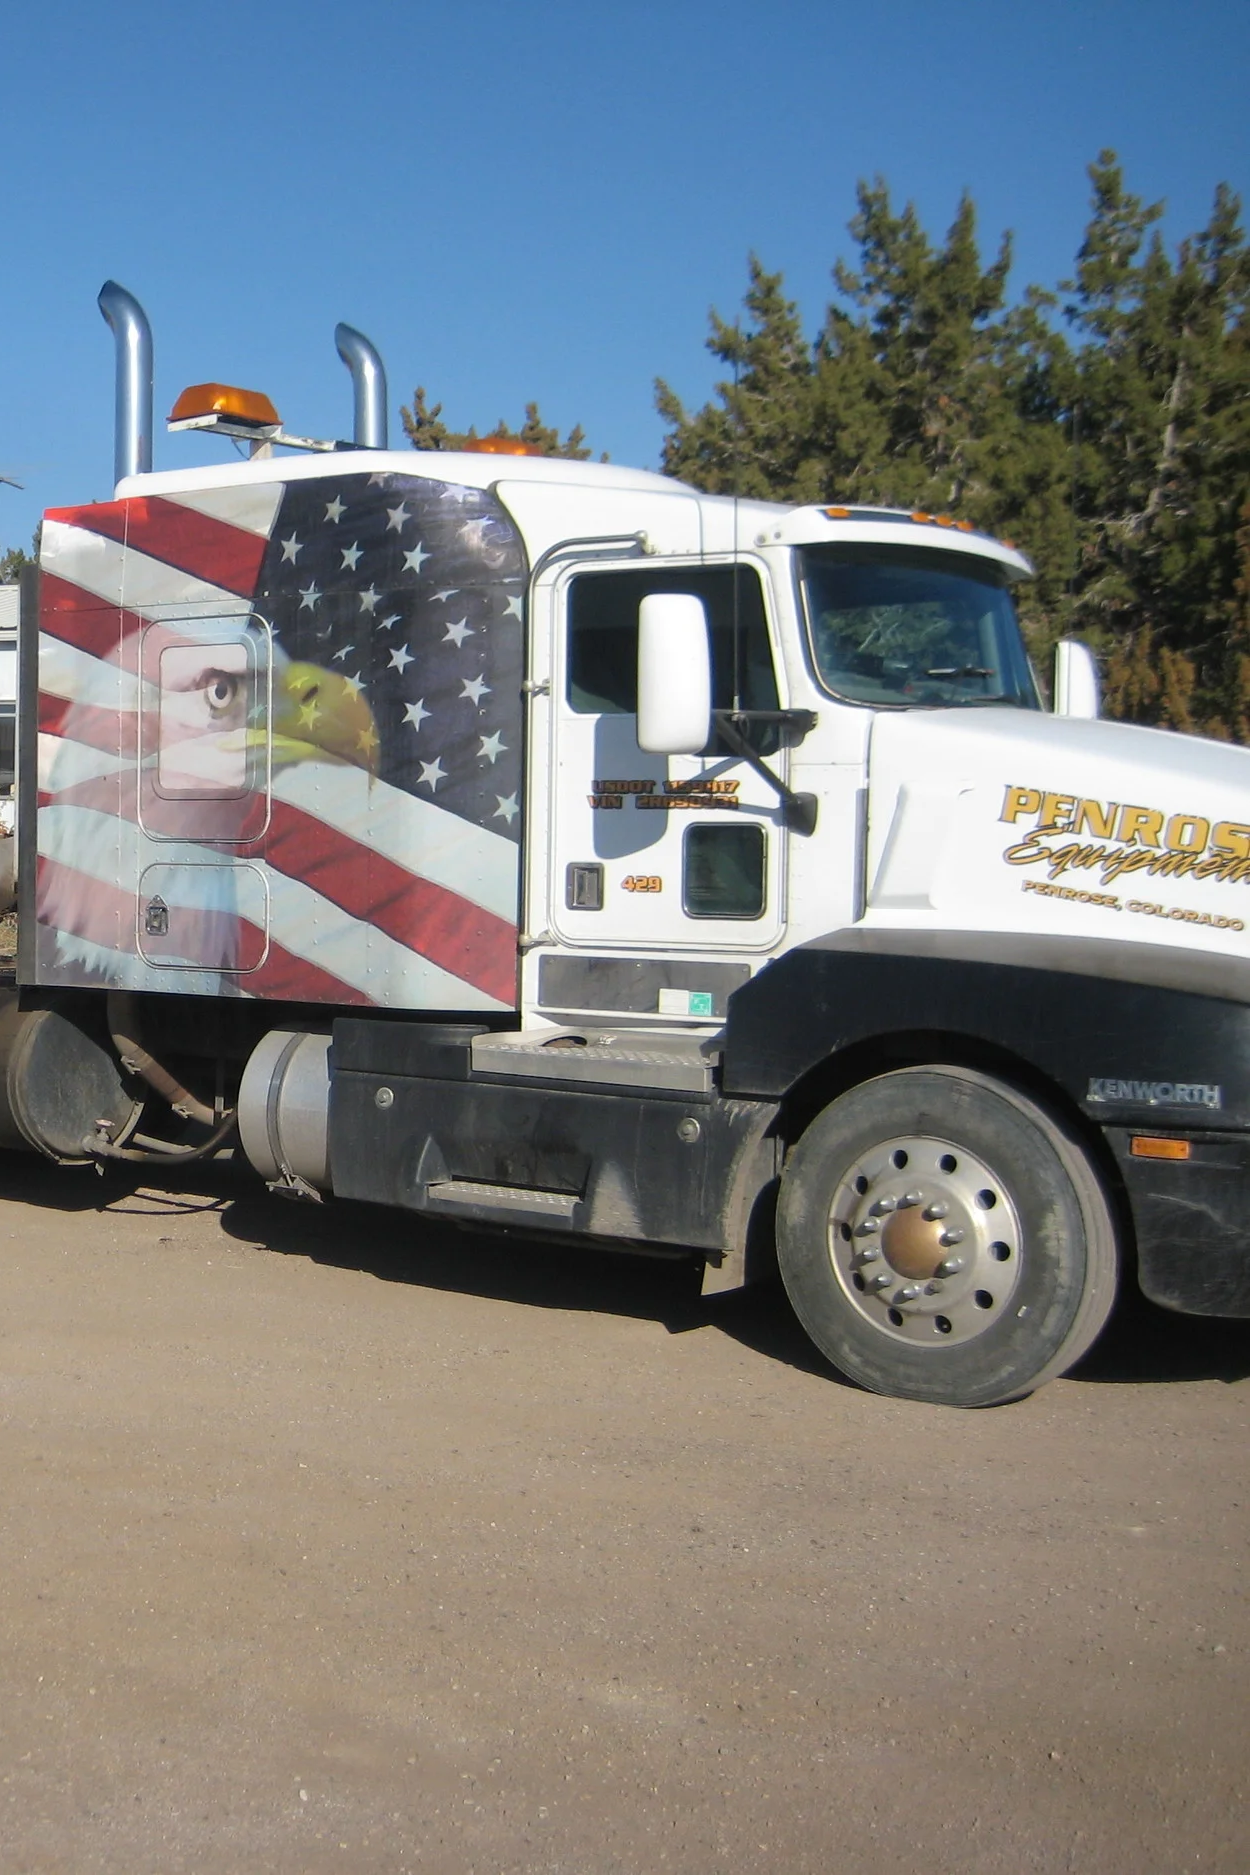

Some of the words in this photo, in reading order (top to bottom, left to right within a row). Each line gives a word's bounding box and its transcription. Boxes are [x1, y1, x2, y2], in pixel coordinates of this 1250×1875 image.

[592, 780, 655, 794] USDOT
[587, 795, 623, 809] VIN
[621, 875, 662, 892] 429
[1021, 880, 1122, 911] PENROSE,
[1125, 899, 1244, 931] COLORADO
[1087, 1078, 1220, 1103] KENWORTH
